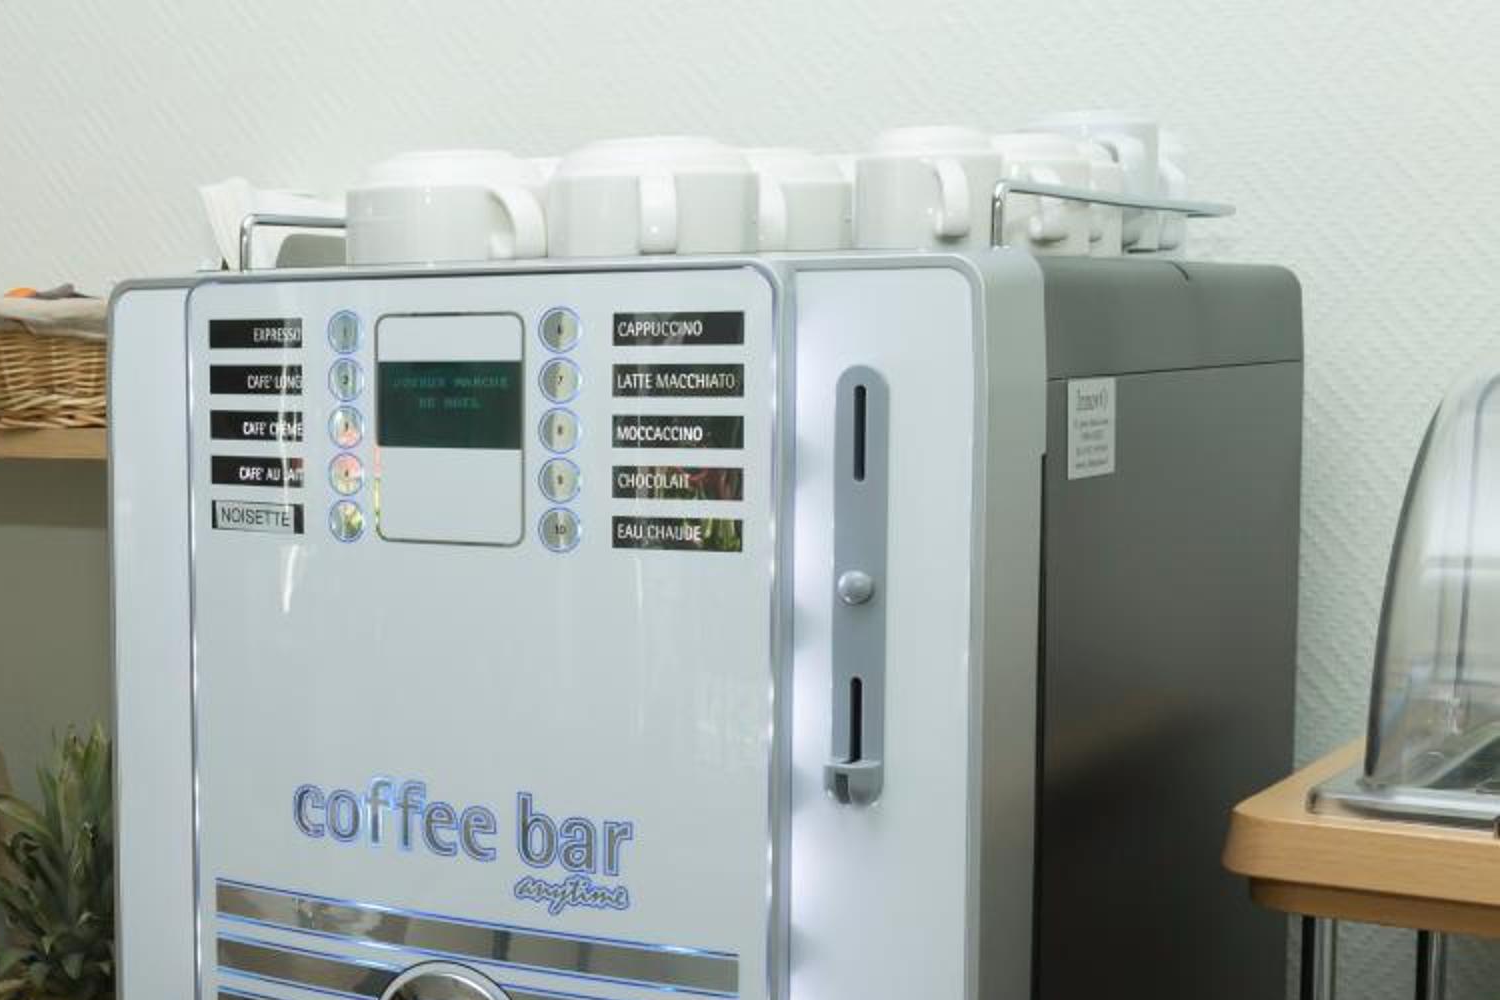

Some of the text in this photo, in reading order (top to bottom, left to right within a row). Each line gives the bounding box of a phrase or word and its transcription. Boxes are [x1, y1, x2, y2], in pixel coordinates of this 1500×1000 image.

[617, 320, 703, 337] CAPPUCCINO
[617, 373, 735, 390] LATTE MACCHIATO
[617, 425, 703, 441] MOCCACCINO
[221, 507, 290, 527] NOISETTE
[617, 523, 703, 541] EAU CHAUDE
[293, 775, 635, 877] coffee bar
[514, 874, 631, 916] anytime
